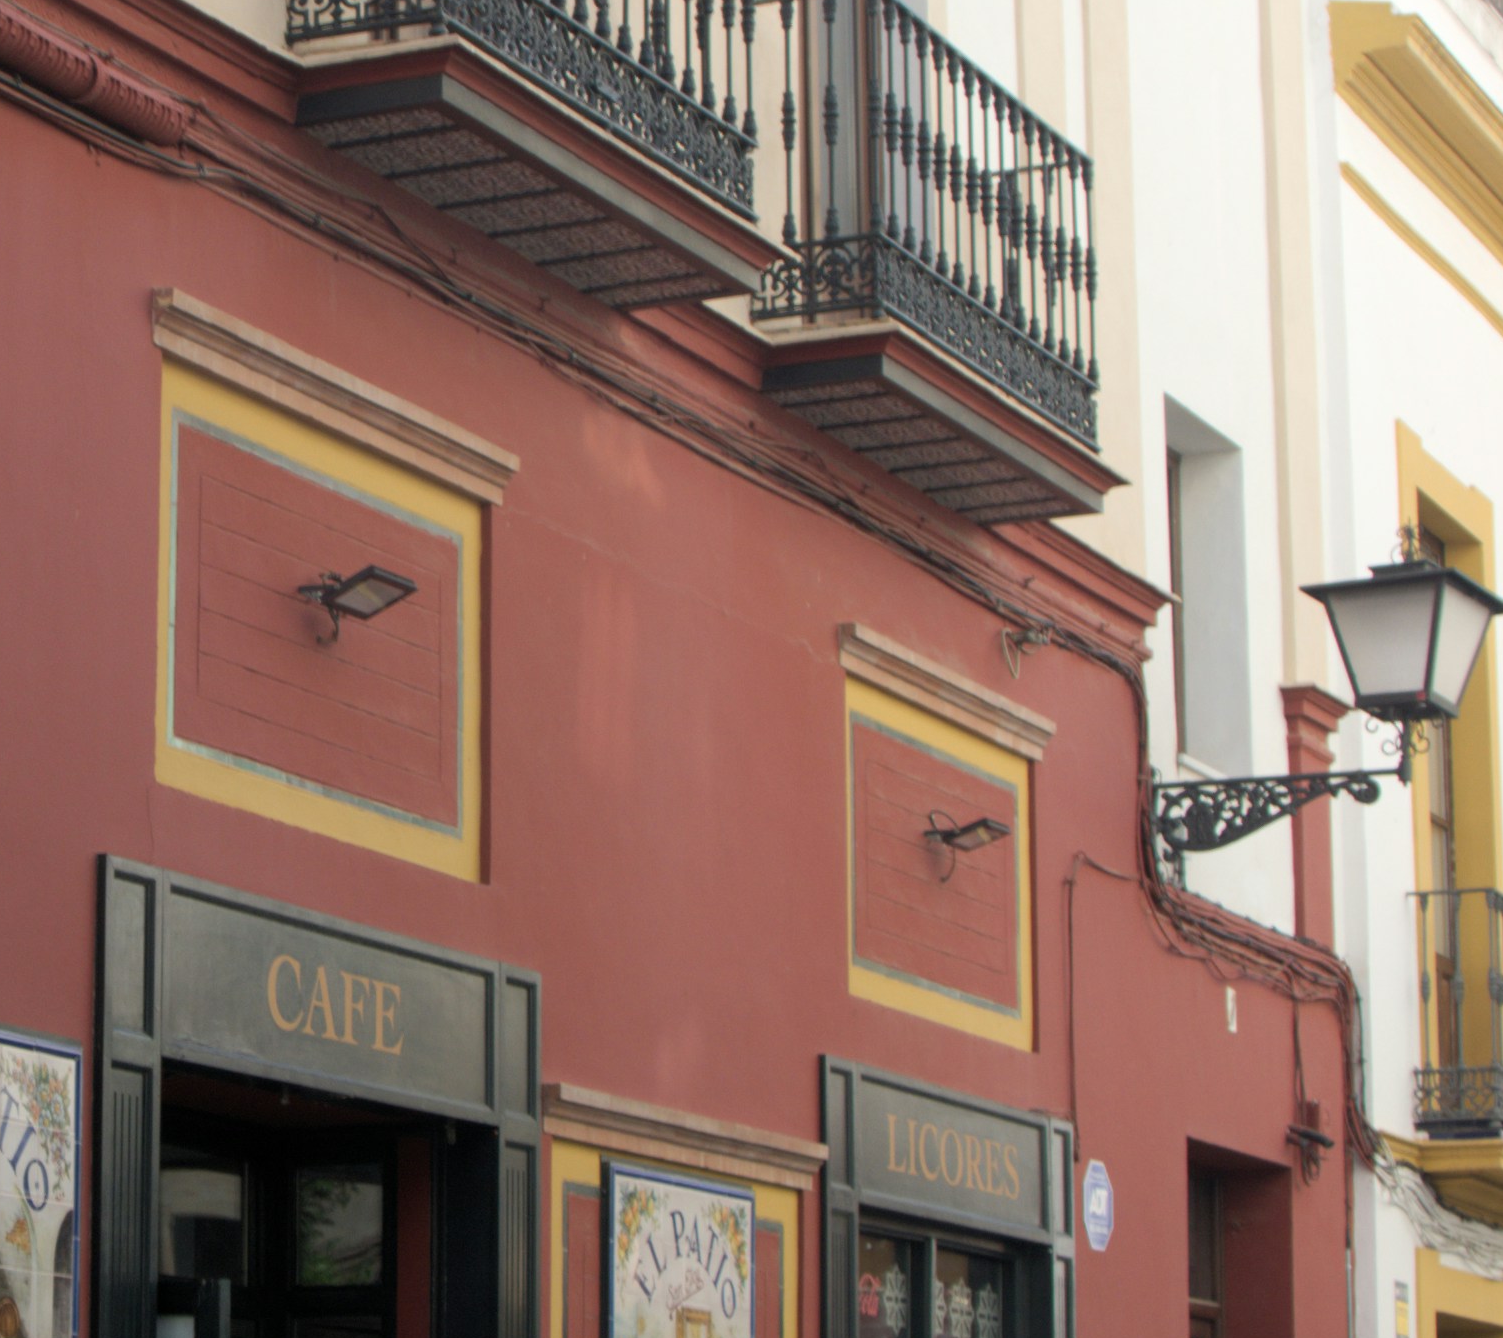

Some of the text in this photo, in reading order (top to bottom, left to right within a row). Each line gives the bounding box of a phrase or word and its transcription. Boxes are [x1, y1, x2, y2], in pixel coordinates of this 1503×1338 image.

[267, 954, 405, 1056] CAFE
[886, 1113, 1020, 1201] LICORES
[633, 1210, 736, 1320] EL PATIO
